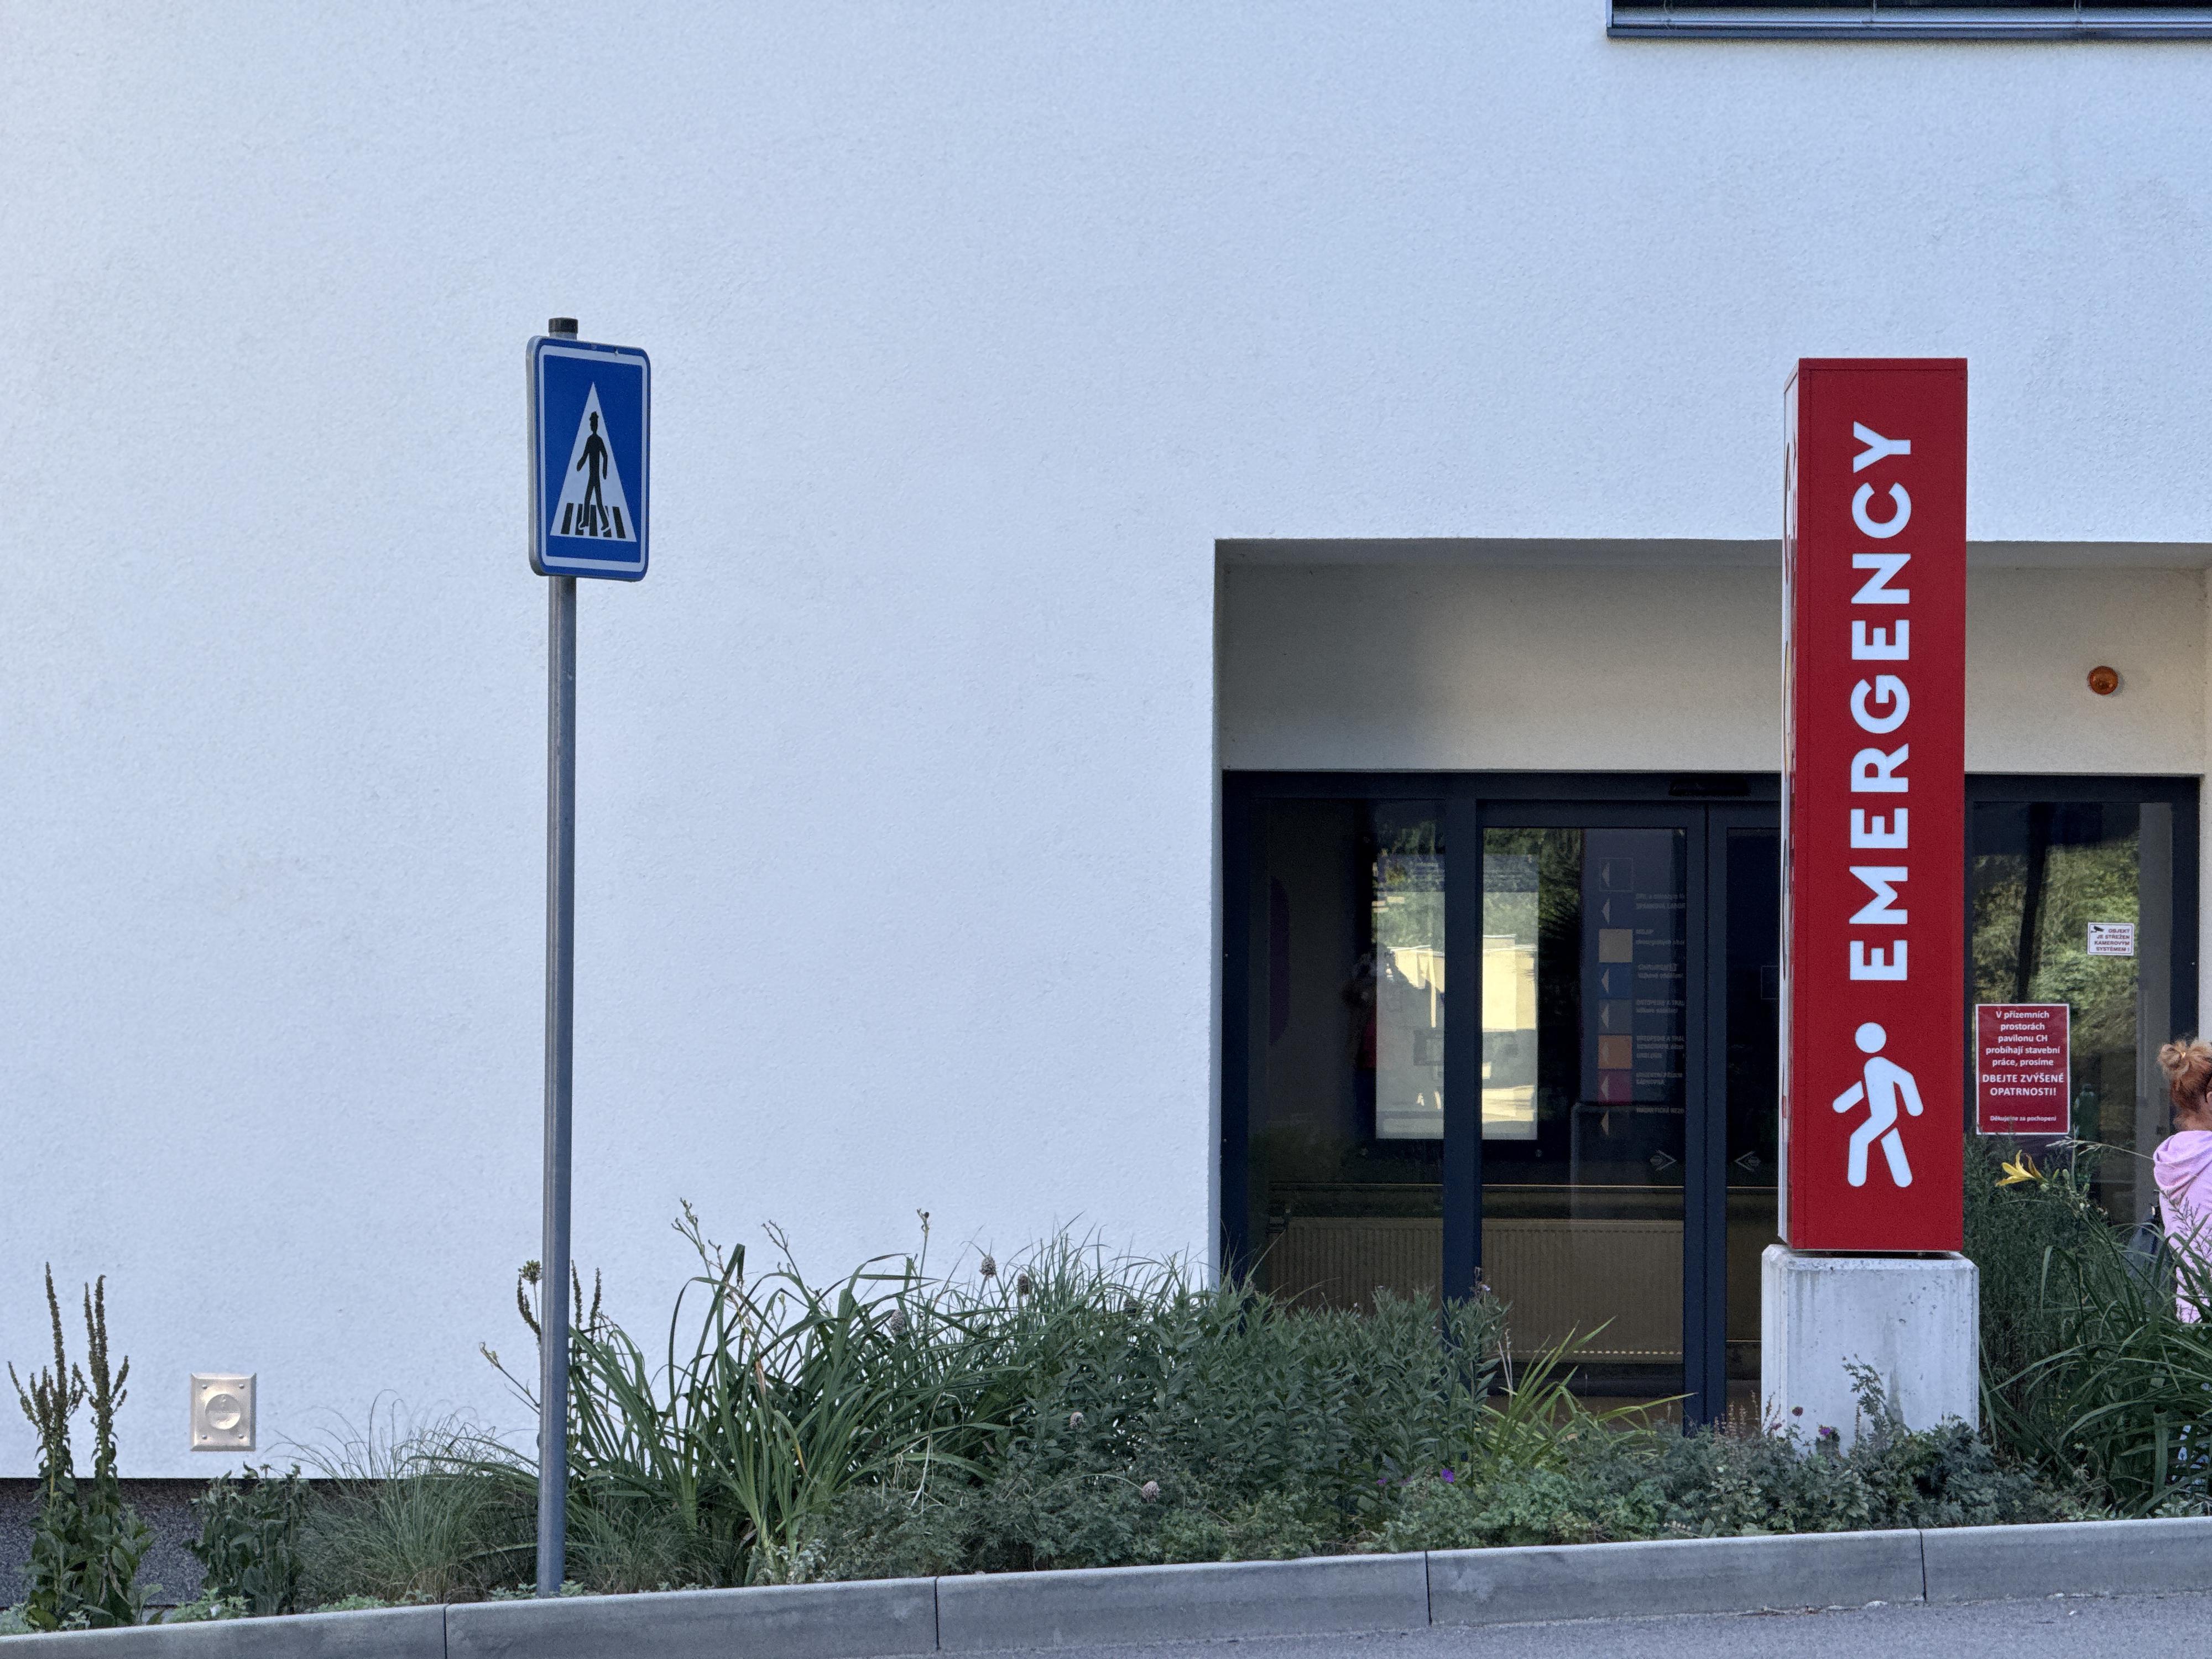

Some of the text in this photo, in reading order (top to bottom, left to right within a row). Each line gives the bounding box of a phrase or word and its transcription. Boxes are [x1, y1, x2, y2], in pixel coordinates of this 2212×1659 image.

[1849, 421, 1912, 981] EMERGENCY
[2004, 1010, 2050, 1020] přízemních
[2000, 1022, 2045, 1031] prostorách
[1997, 1034, 2048, 1043] pavilonu CH
[1985, 1046, 2060, 1056] probíhají stavební
[1992, 1057, 2054, 1067] práce, prosíme
[1982, 1072, 2064, 1083] DBEJTE ZVÝŠENÉ
[1990, 1087, 2057, 1096] OPATRNOSTI!
